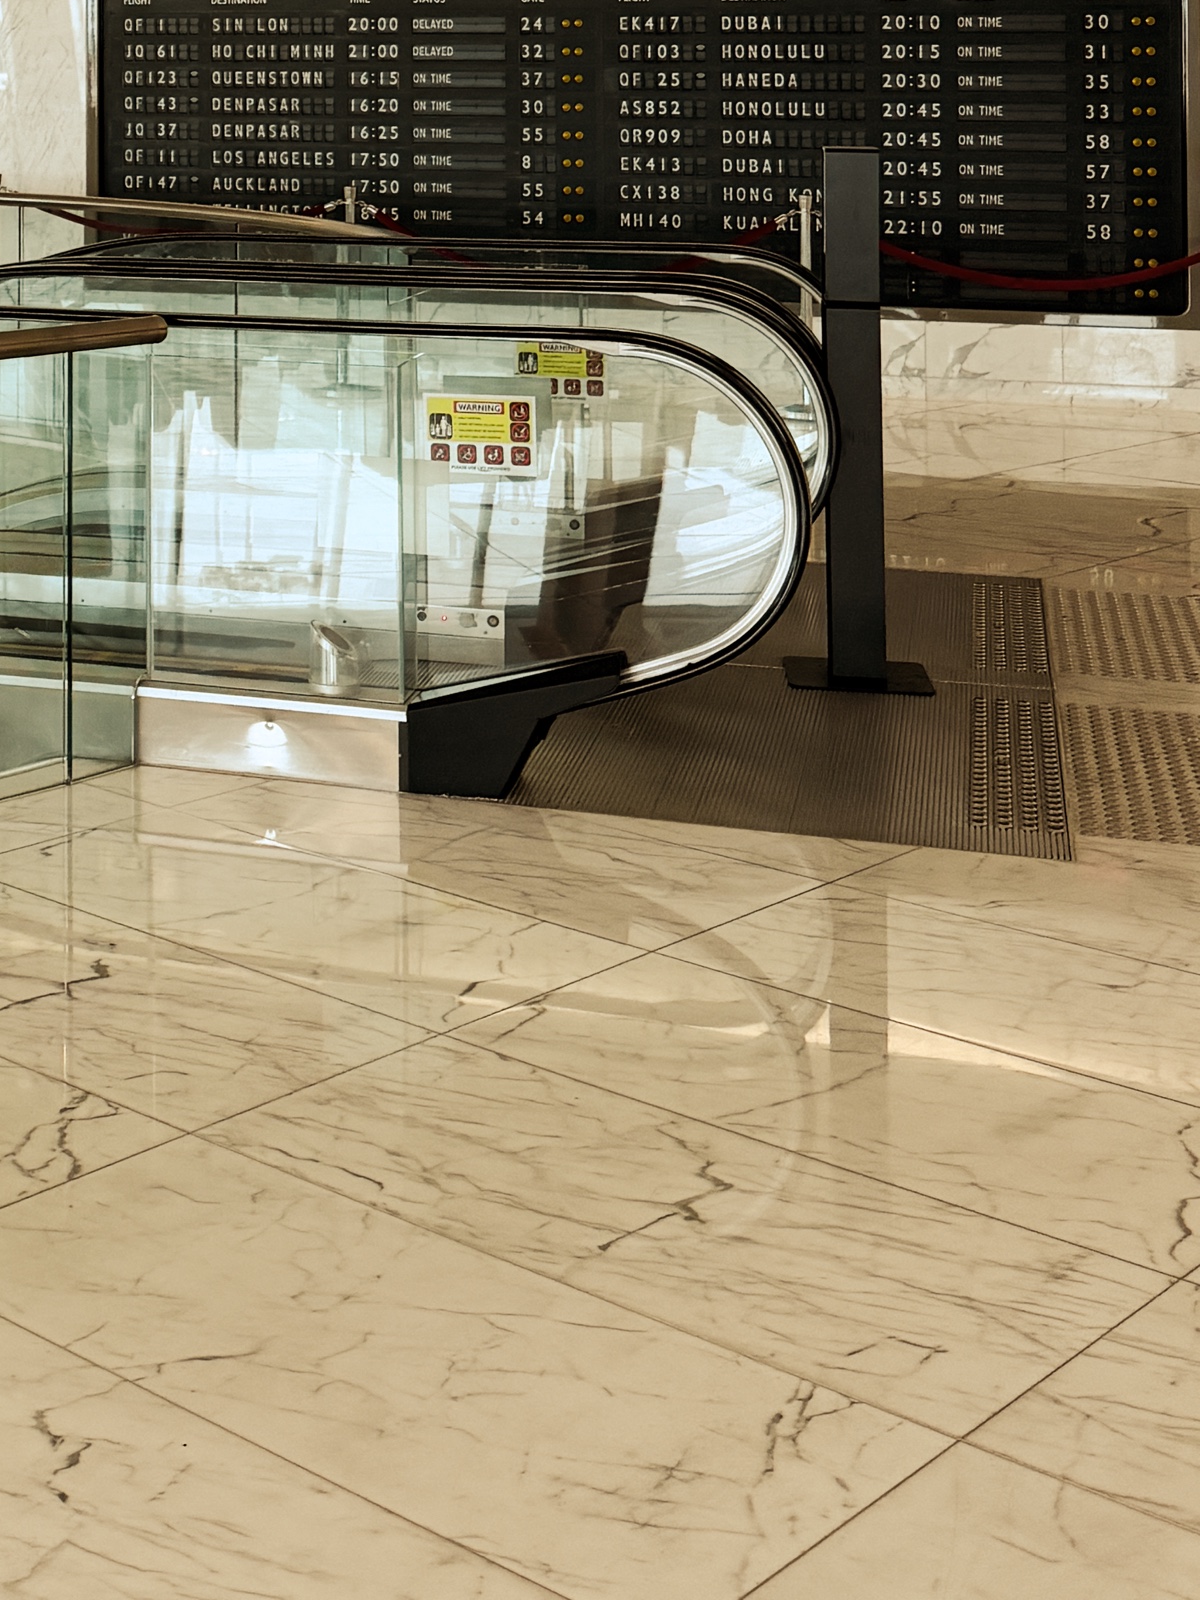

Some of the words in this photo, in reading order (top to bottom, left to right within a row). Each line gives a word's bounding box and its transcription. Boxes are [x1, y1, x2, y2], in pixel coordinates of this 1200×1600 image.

[159, 18, 164, 32] 1
[212, 17, 243, 32] SIN
[257, 17, 288, 32] LON
[348, 17, 398, 32] 20:00
[412, 18, 454, 30] DELAYED
[521, 16, 543, 31] 24
[619, 16, 680, 31] EK417
[721, 15, 781, 31] DUBAI
[881, 15, 940, 30] 20:10
[957, 16, 973, 28] ON
[978, 16, 1003, 28] TIME
[1085, 14, 1109, 30] 30
[157, 44, 174, 58] 61
[212, 44, 232, 58] HO
[246, 44, 275, 59] CHI
[290, 44, 334, 58] MINH
[348, 44, 399, 59] 21:00
[412, 45, 454, 57] DELAYED
[521, 44, 543, 58] 32
[721, 44, 824, 59] HONOLULU
[882, 44, 940, 59] 20:15
[957, 46, 973, 57] ON
[977, 46, 1003, 58] TIME
[1085, 44, 1106, 60] 31
[212, 70, 323, 85] QUEENSTOWN
[351, 71, 400, 85] 16:15
[412, 73, 427, 84] ON
[430, 73, 452, 84] TIME
[521, 71, 543, 86] 37
[657, 72, 680, 87] 25
[722, 72, 798, 88] HANEDA
[882, 73, 941, 89] 20:30
[957, 75, 973, 87] ON
[977, 75, 1003, 87] TIME
[1085, 74, 1109, 90] 35
[157, 96, 176, 111] 43
[212, 97, 300, 112] DENPASAR
[351, 98, 399, 113] 16:20
[413, 100, 427, 111] ON
[430, 100, 452, 112] TIME
[522, 99, 543, 114] 30
[619, 100, 681, 115] AS852
[722, 101, 825, 117] HONOLULU
[882, 102, 941, 118] 20:45
[958, 105, 974, 116] ON
[978, 105, 1003, 117] TIME
[1085, 104, 1109, 120] 33
[157, 122, 177, 137] 37
[212, 123, 300, 139] DENPASAR
[351, 125, 399, 140] 16:25
[412, 127, 427, 139] ON
[430, 127, 452, 139] TIME
[522, 127, 543, 142] 55
[722, 129, 772, 145] DOHA
[882, 131, 941, 147] 20:45
[958, 134, 974, 146] ON
[978, 134, 1004, 146] TIME
[1085, 134, 1110, 150] 58
[159, 149, 175, 163] 11
[212, 150, 243, 165] LOS
[257, 151, 334, 166] ANGELES
[351, 152, 399, 167] 17:50
[413, 154, 427, 166] ON
[430, 155, 452, 166] TIME
[522, 155, 531, 169] 8
[620, 156, 680, 172] EK413
[722, 158, 783, 174] DUBAI
[883, 161, 942, 177] 20:45
[958, 164, 974, 175] ON
[979, 164, 1004, 176] TIME
[1086, 164, 1110, 179] 57
[212, 177, 300, 192] AUCKLAND
[413, 182, 427, 193] ON
[431, 182, 452, 194] TIME
[522, 182, 544, 197] 55
[620, 184, 680, 200] CX138
[723, 187, 773, 202] HONG
[883, 190, 941, 206] 21:55
[959, 193, 975, 205] ON
[979, 193, 1004, 206] TIME
[1086, 194, 1110, 209] 37
[413, 209, 427, 220] ON
[431, 210, 452, 221] TIME
[522, 210, 544, 225] 54
[620, 212, 681, 229] MH140
[884, 219, 942, 236] 22:10
[959, 223, 975, 234] ON
[979, 223, 1005, 236] TIME
[1086, 224, 1111, 240] 58
[458, 403, 501, 413] WARNING
